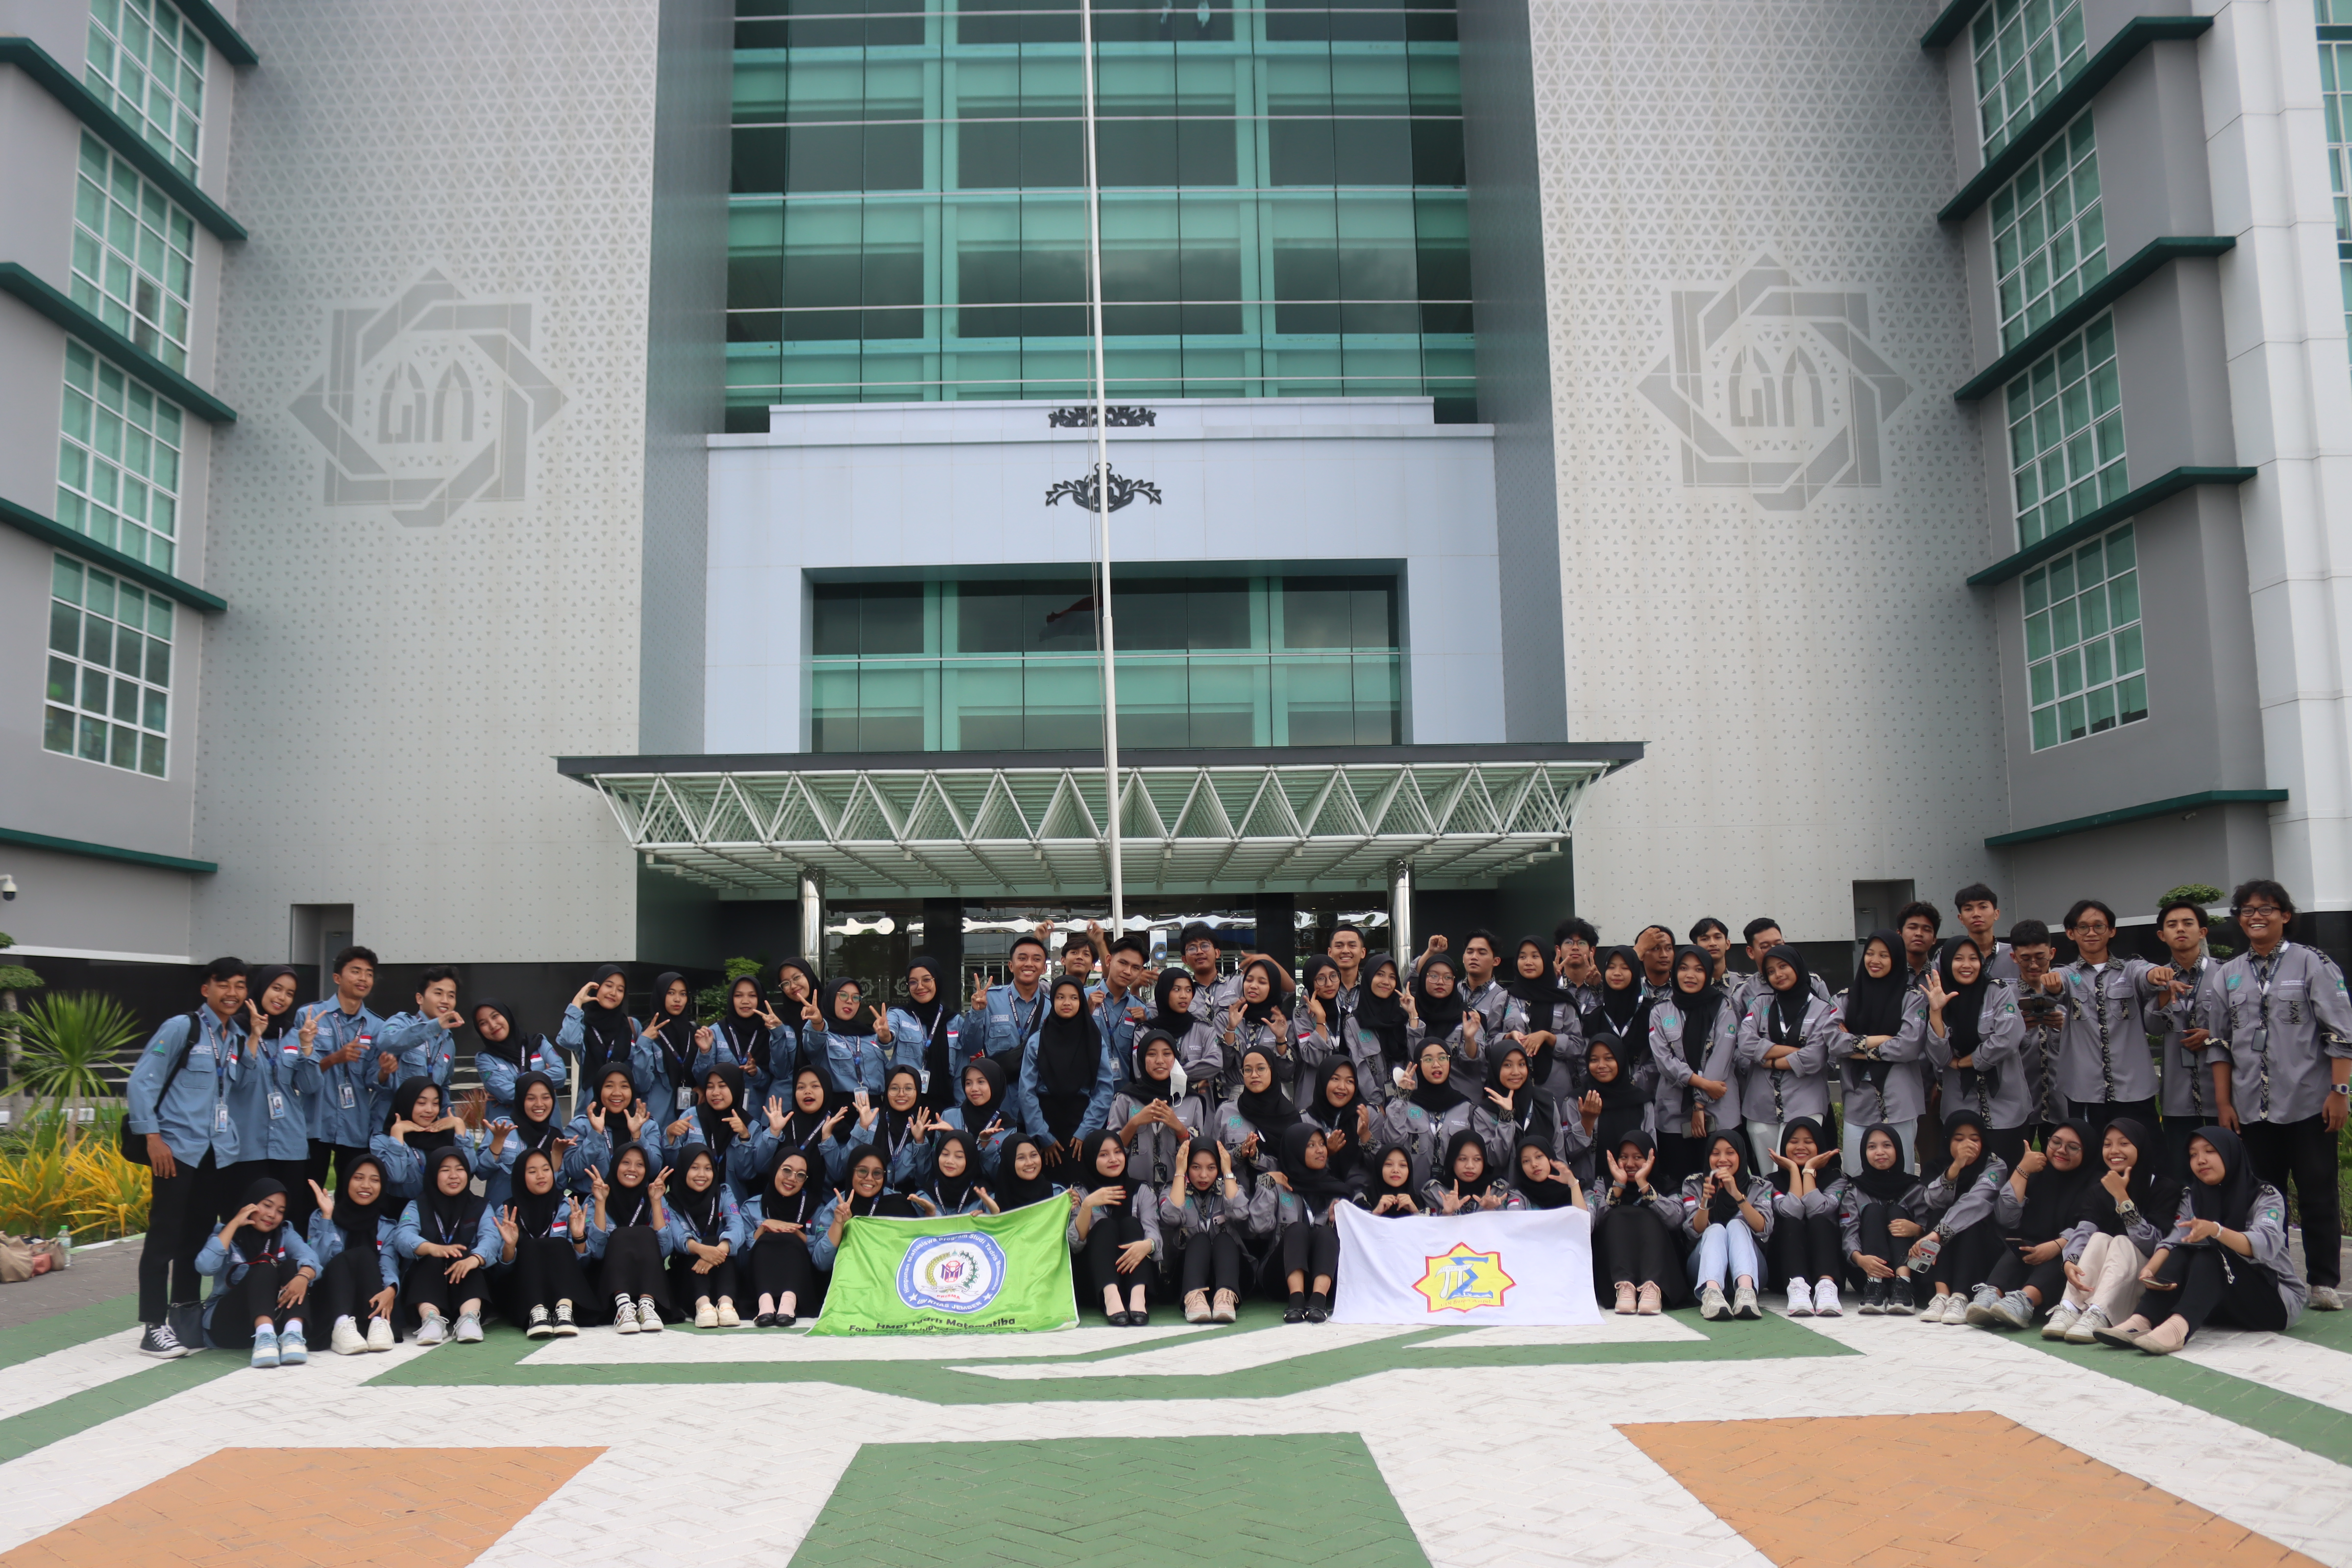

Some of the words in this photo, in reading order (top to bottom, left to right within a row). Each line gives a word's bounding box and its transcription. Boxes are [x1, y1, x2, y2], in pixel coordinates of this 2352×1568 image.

[814, 1119, 826, 1134] EDUCATION
[632, 1204, 642, 1223] EDUCATION
[908, 1237, 937, 1262] Mahasiswa
[938, 1233, 968, 1242] Program
[969, 1234, 986, 1245] Studi
[985, 1243, 998, 1262] Tadris
[927, 1299, 950, 1308] KHAS
[951, 1301, 982, 1311] JEMBER
